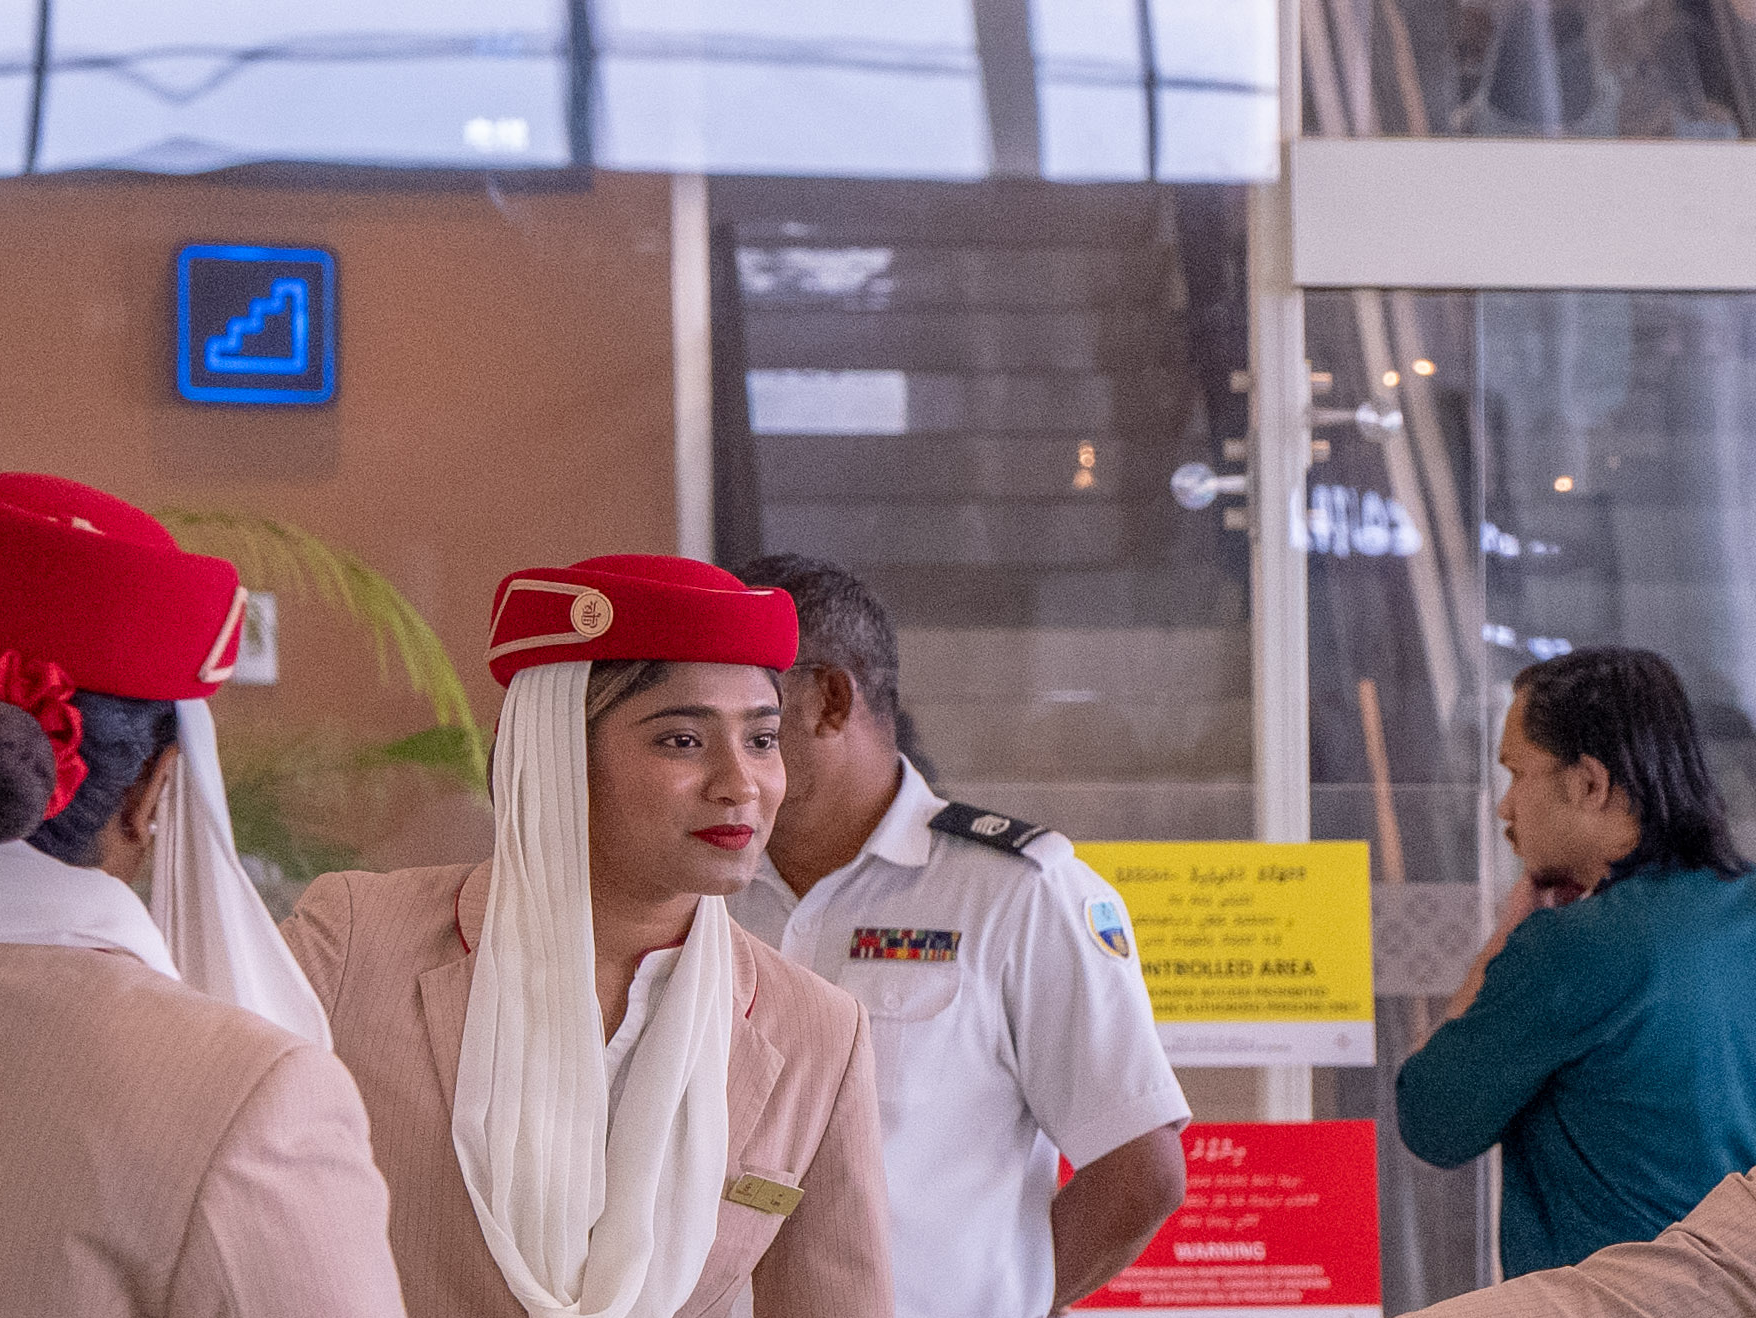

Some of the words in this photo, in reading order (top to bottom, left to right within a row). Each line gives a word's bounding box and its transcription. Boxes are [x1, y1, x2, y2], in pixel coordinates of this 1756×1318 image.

[1142, 959, 1254, 977] NTROLLED
[1259, 959, 1316, 977] AREA
[1173, 1242, 1267, 1261] WARNING
